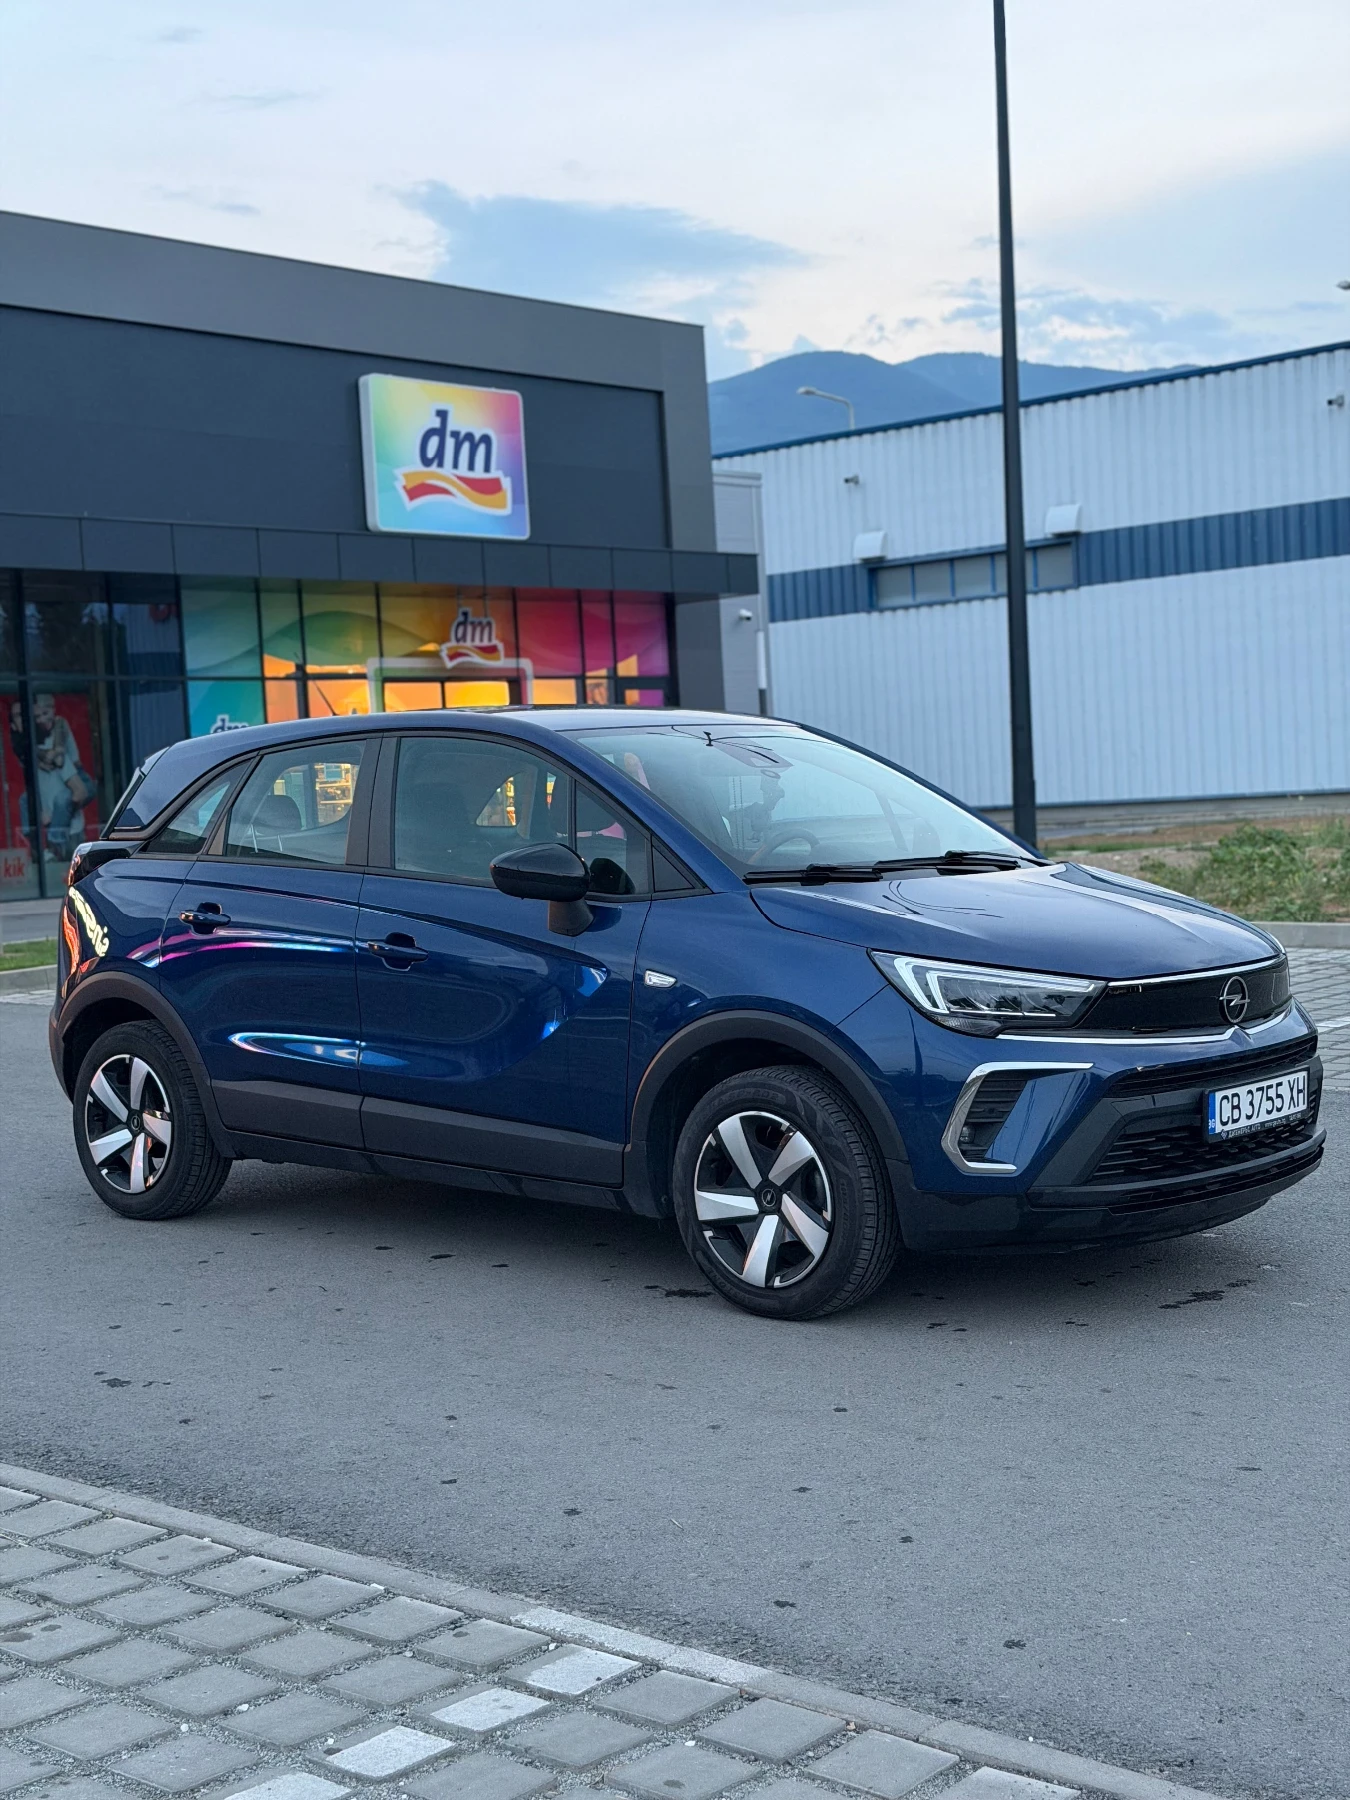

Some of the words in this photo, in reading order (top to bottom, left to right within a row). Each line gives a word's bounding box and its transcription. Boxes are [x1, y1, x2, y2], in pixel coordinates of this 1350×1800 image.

[419, 409, 493, 473] dm
[455, 611, 492, 643] dm
[1220, 1092, 1241, 1126] CB
[1245, 1081, 1284, 1120] 3755
[1287, 1075, 1306, 1110] XH
